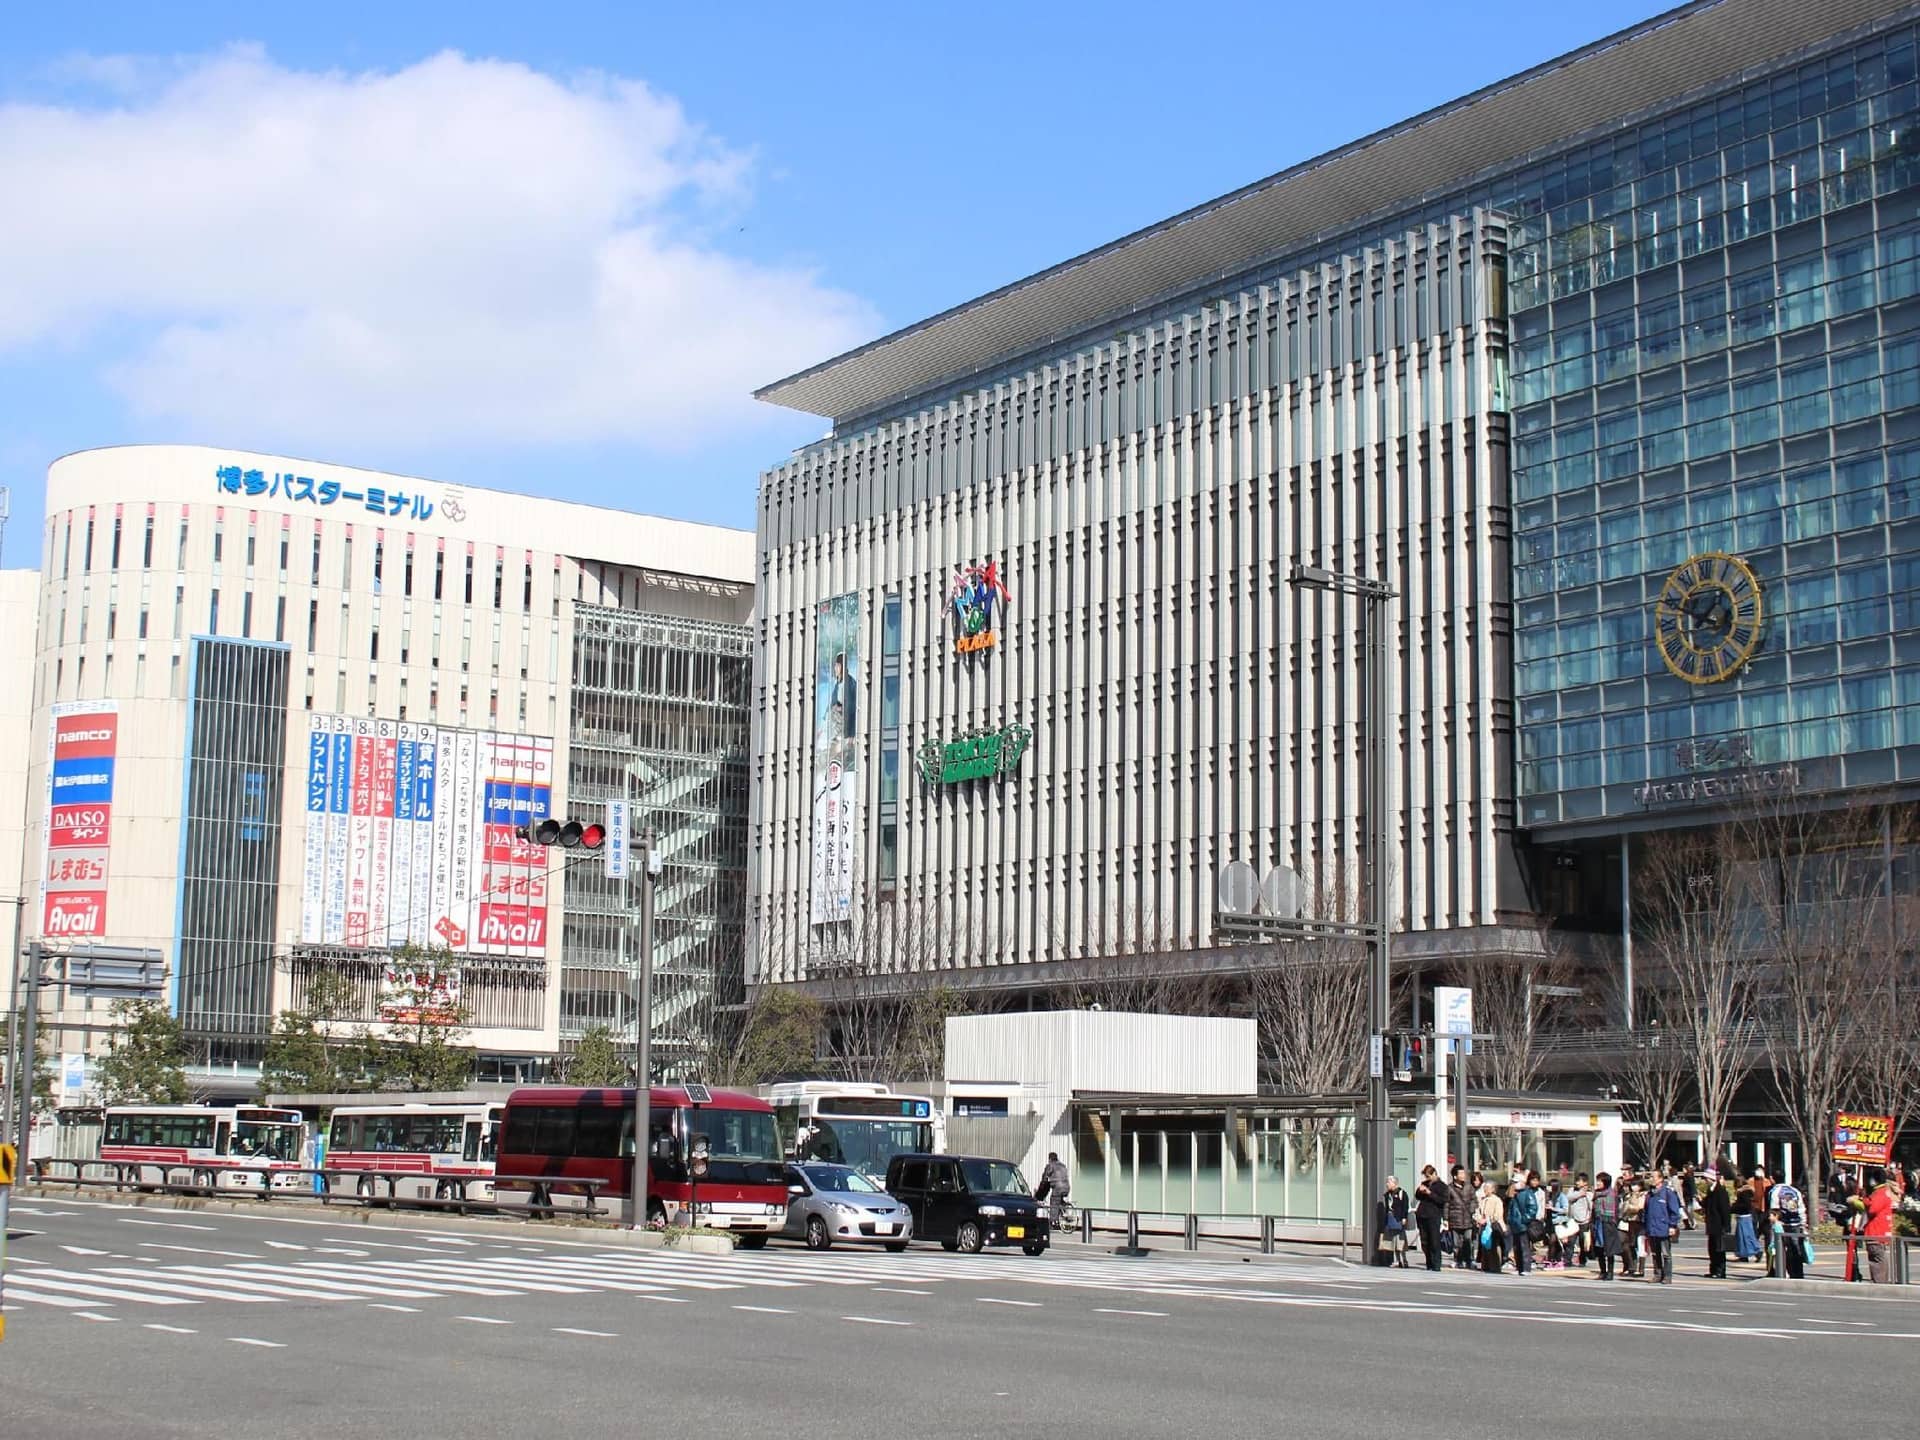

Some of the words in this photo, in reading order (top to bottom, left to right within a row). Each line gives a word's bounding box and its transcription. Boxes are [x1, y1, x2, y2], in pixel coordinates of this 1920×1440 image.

[215, 465, 435, 521] 博多バスターミナル
[956, 631, 996, 653] PLAZA
[58, 730, 113, 744] namco
[944, 734, 1001, 762] TOKYU
[311, 734, 326, 810] ソフトバンク
[490, 757, 546, 771] namco
[943, 757, 997, 783] HANDS
[416, 744, 434, 818] 貸ホール
[55, 811, 106, 827] DAISO
[72, 828, 104, 840] ダイソー
[50, 858, 105, 881] しまむら
[352, 818, 368, 908] シャワー無料
[482, 873, 546, 897] しまむら
[48, 904, 99, 932] Avail
[350, 913, 365, 926] 24
[481, 915, 542, 942] Avail
[1839, 1115, 1888, 1131] ネットカフェ
[1856, 1131, 1888, 1145] ポパイ
